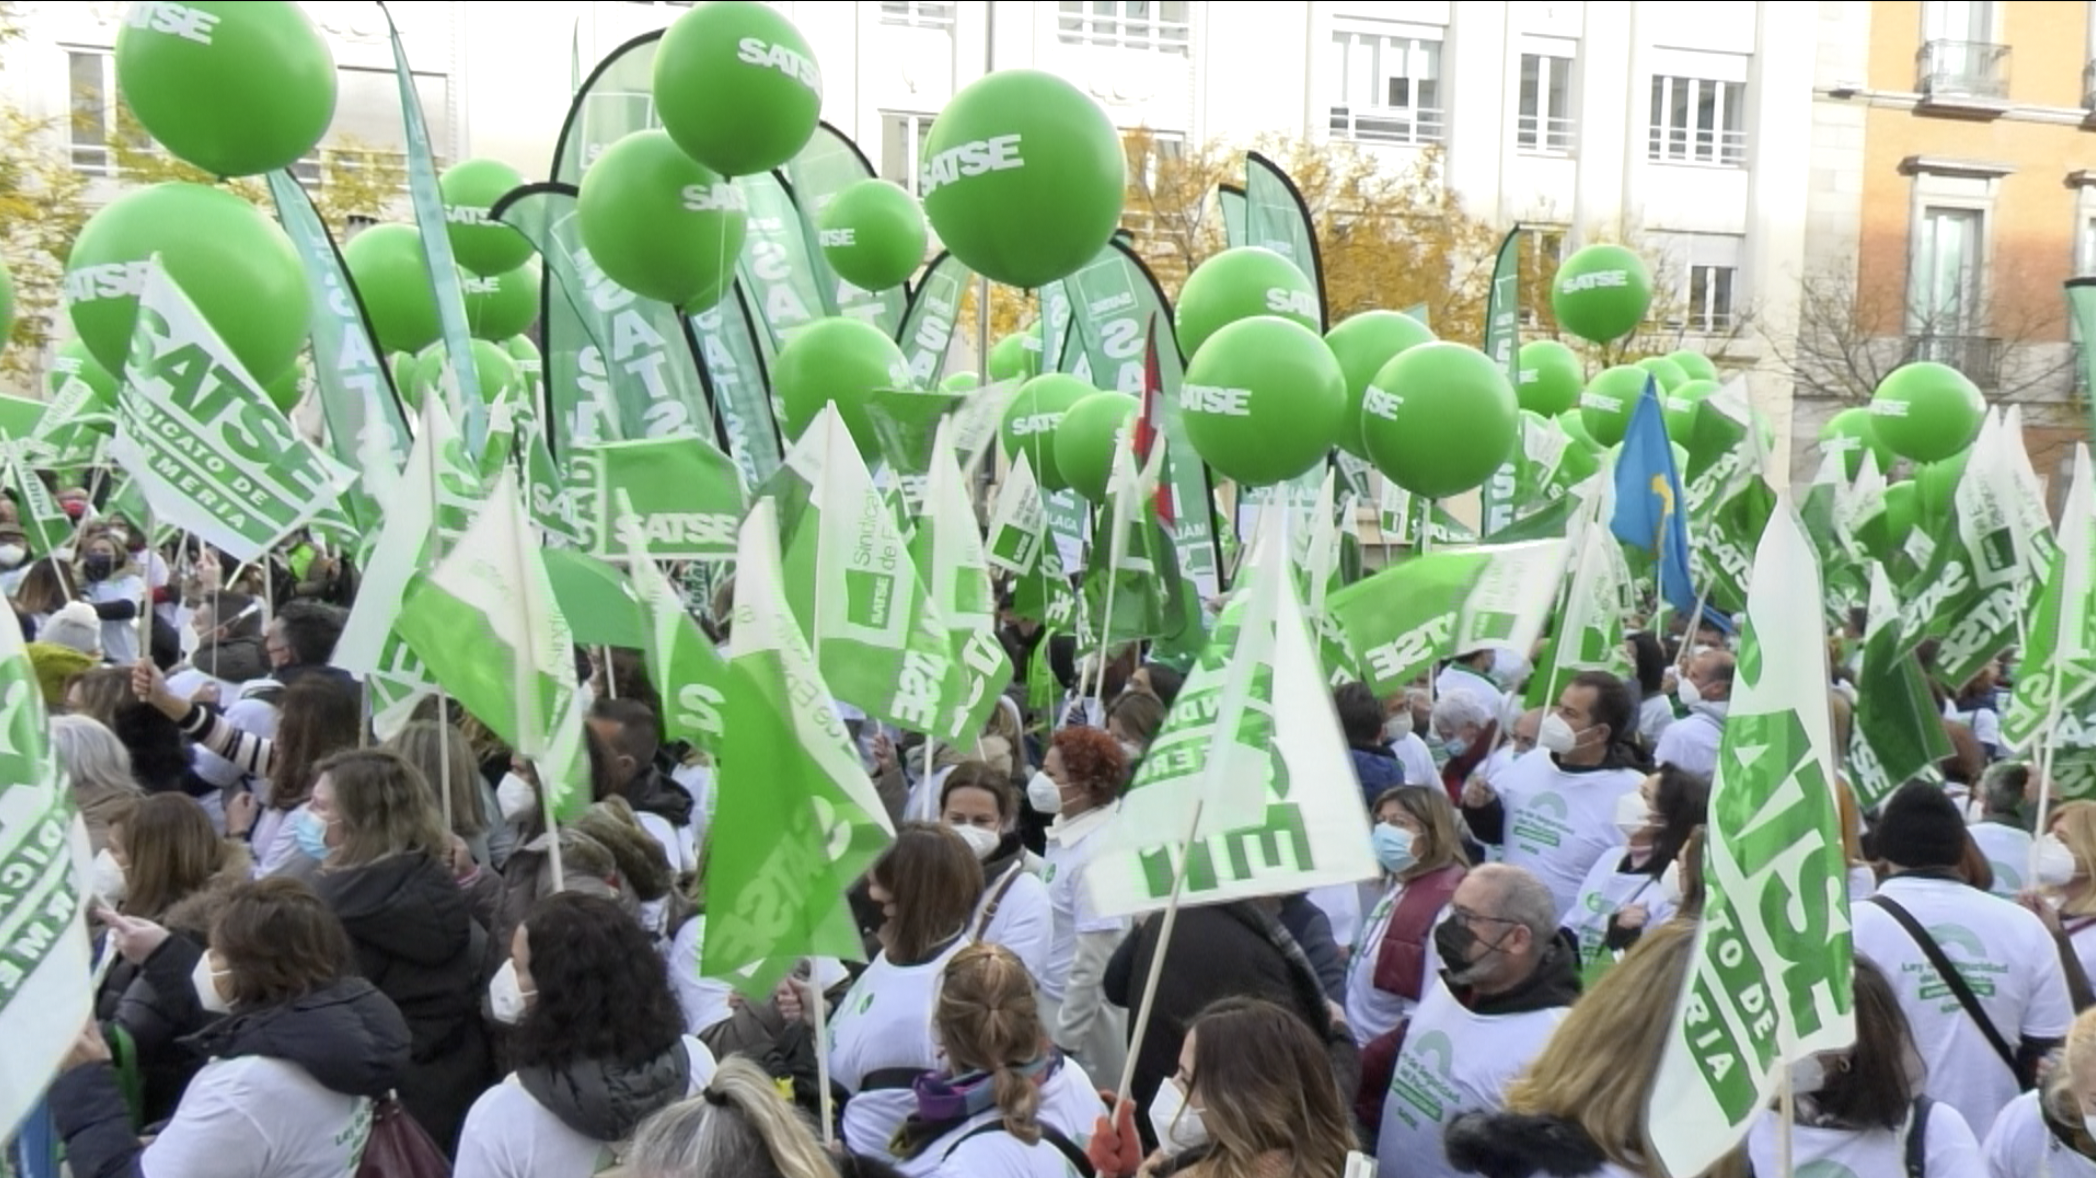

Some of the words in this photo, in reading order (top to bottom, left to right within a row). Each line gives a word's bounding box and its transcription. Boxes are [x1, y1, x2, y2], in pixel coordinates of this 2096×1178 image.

[737, 37, 822, 99] SATS
[919, 133, 1025, 197] SATSE
[1562, 269, 1628, 295] SATSE
[1362, 384, 1404, 421] TSE
[1012, 413, 1064, 436] SATS
[232, 474, 273, 507] DE
[1050, 512, 1080, 532] LAGA
[1739, 982, 1776, 1041] DE
